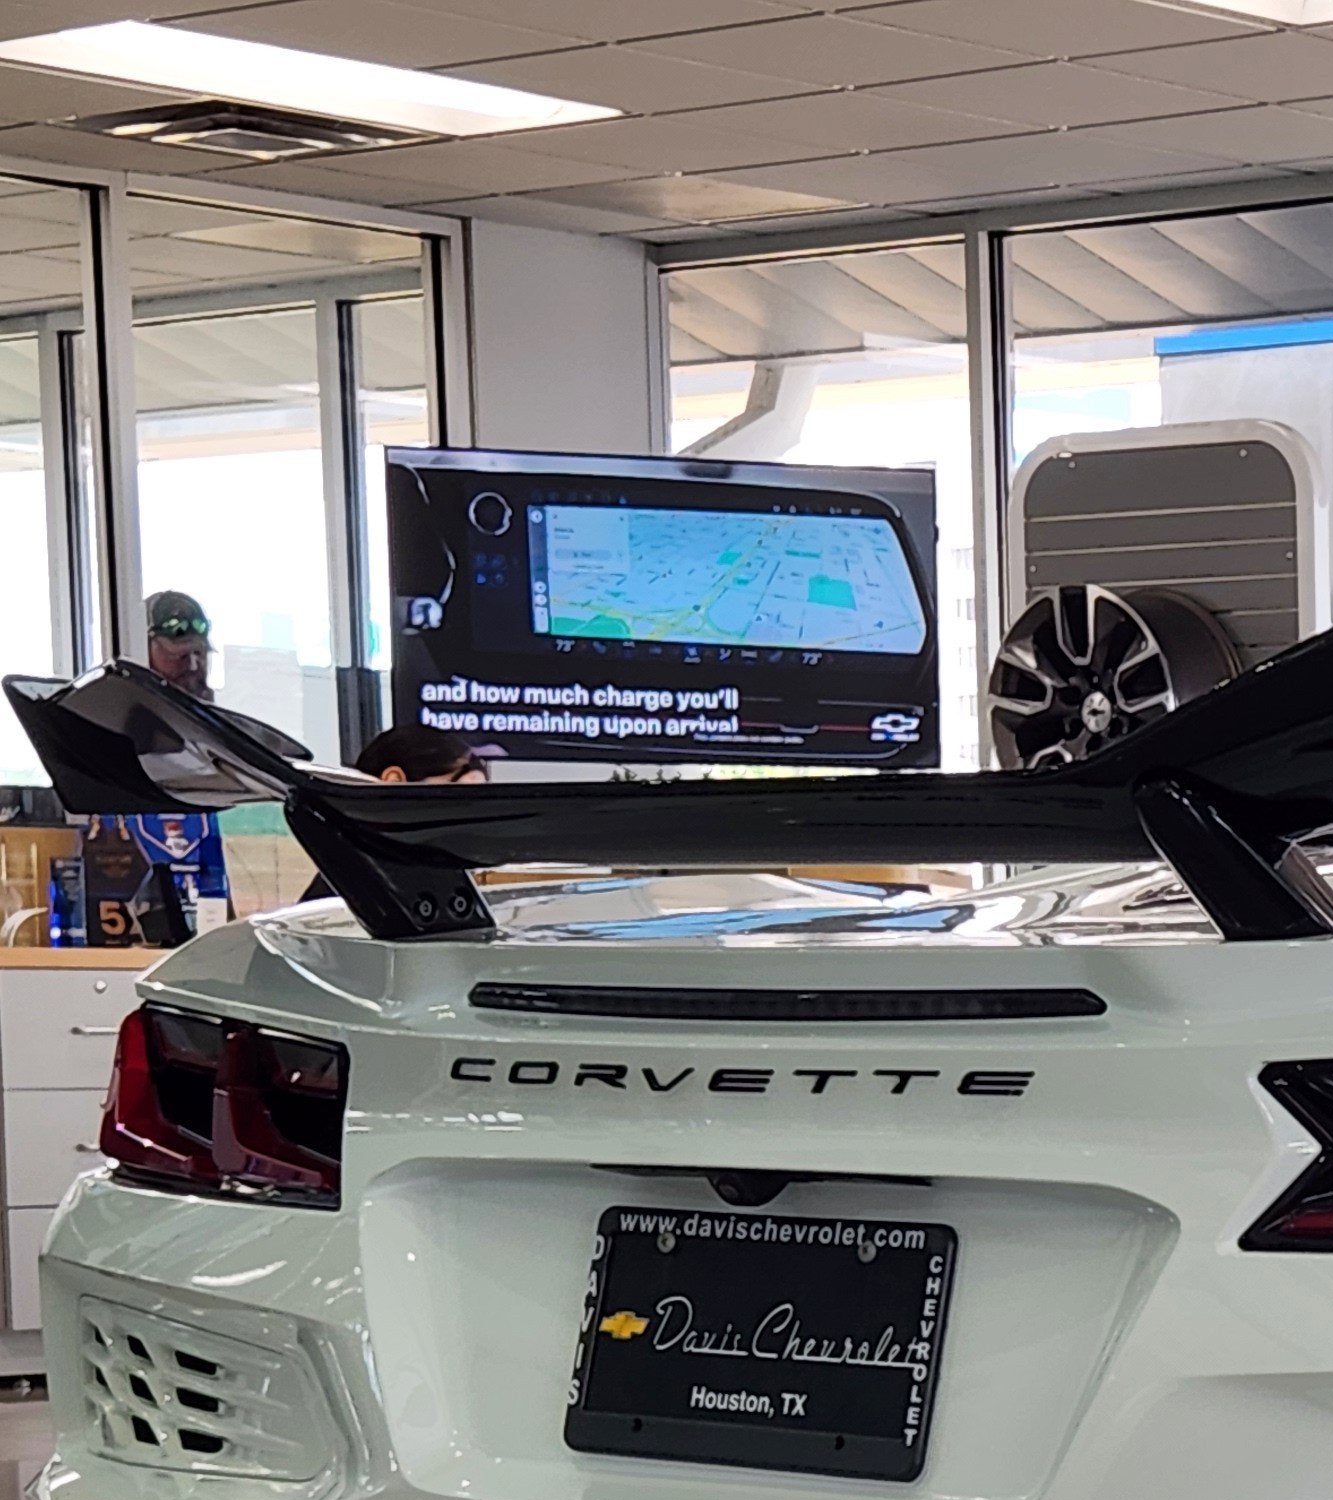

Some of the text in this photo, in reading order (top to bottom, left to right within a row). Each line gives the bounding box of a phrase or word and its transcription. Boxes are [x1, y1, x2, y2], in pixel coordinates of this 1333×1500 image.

[420, 677, 468, 703] and
[470, 680, 521, 704] how
[523, 683, 590, 706] much
[592, 684, 674, 712] charge
[420, 706, 739, 738] have remaining upon arrival
[99, 900, 127, 936] 5
[449, 1056, 1036, 1098] CORVETTE
[619, 1212, 926, 1250] www.davischevroletcom
[653, 1295, 920, 1370] Davis Chevrolet
[903, 1255, 944, 1447] CHEVROLET
[690, 1385, 808, 1418] Houston, TX
